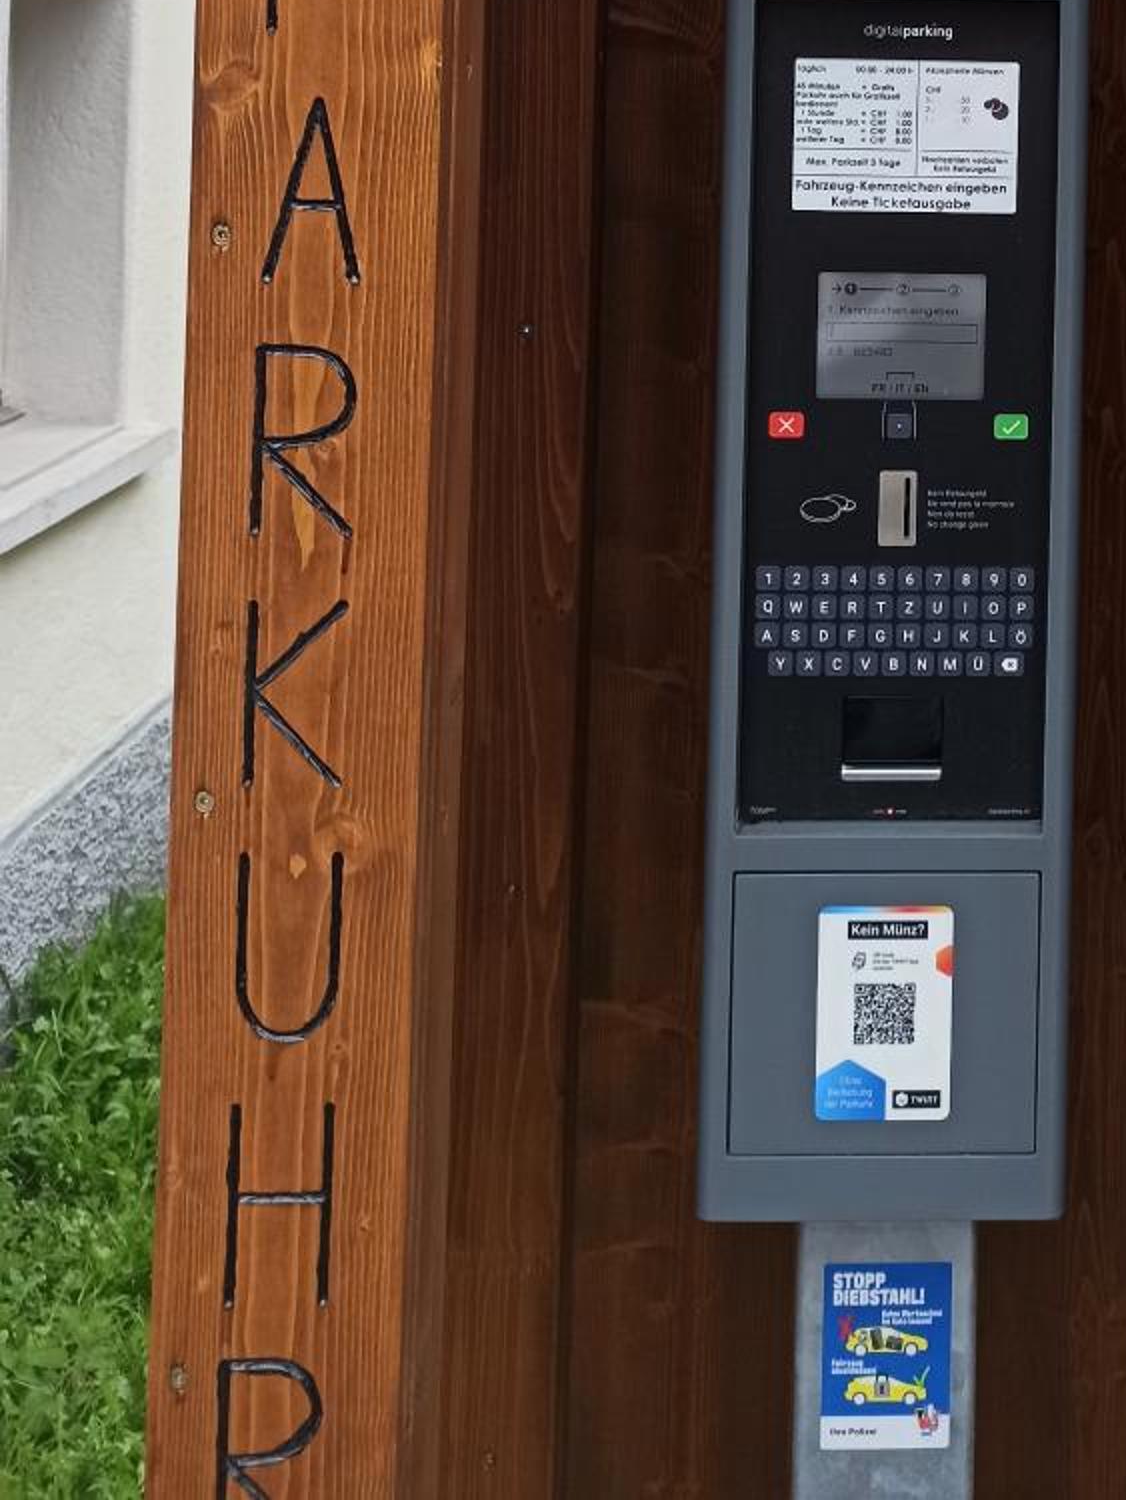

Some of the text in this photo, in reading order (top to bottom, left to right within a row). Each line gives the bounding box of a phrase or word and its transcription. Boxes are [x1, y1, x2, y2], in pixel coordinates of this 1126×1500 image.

[863, 22, 953, 41] digitalparking
[796, 179, 1008, 196] Fahrzeug-Kennzeichen eingeben
[831, 195, 971, 212] Keine Ticketausgabe
[792, 572, 802, 586] 2
[820, 572, 830, 586] 3
[849, 572, 858, 586] 4
[877, 572, 887, 586] 5
[905, 572, 915, 586] 6
[933, 573, 943, 586] 7
[961, 573, 971, 587] 8
[989, 573, 999, 586] 9
[1017, 573, 1027, 587] 0
[762, 600, 774, 616] Q
[789, 600, 803, 614] W
[819, 600, 829, 614] E
[847, 601, 857, 614] R
[875, 601, 887, 614] T
[903, 601, 914, 615] Z
[932, 601, 943, 615] U
[988, 601, 999, 615] O
[1016, 601, 1027, 615] P
[761, 628, 1027, 644] A S D F G H J K L Ö
[775, 656, 984, 671] Y X C V B N M Ü
[851, 922, 925, 937] Kein Münz?
[833, 1272, 886, 1289] STOPP
[833, 1288, 926, 1307] DIEBSTAHL!
